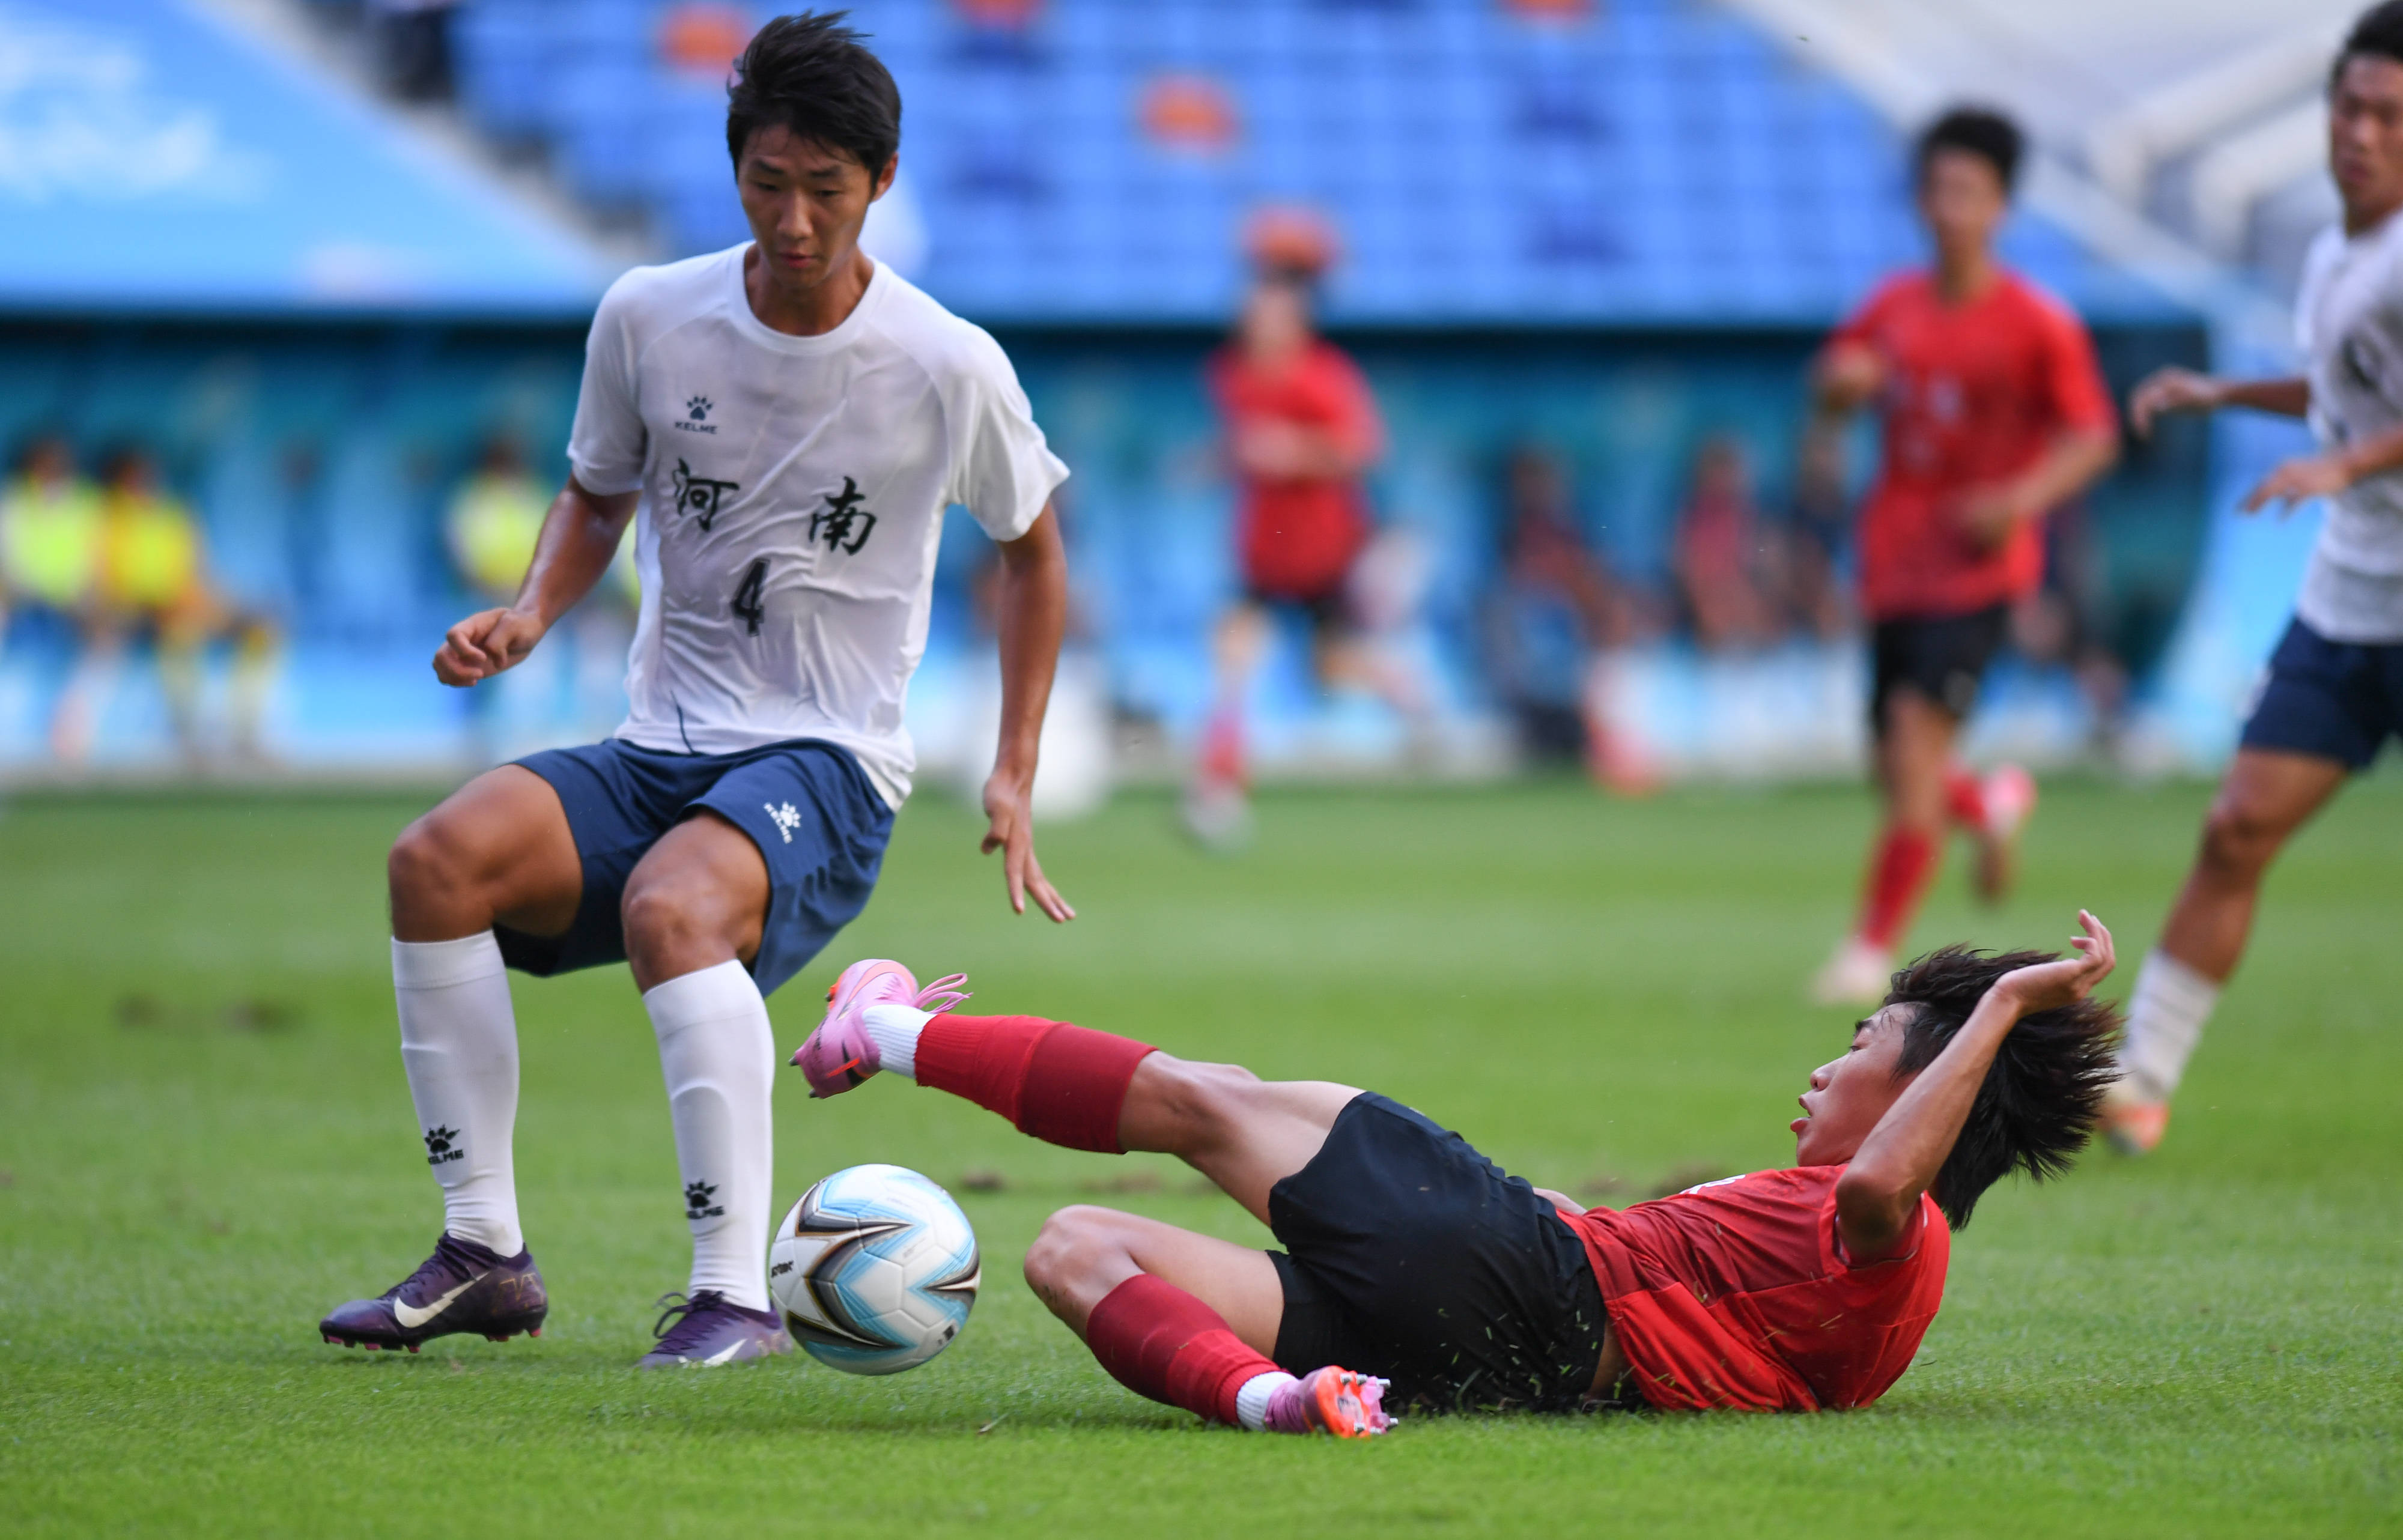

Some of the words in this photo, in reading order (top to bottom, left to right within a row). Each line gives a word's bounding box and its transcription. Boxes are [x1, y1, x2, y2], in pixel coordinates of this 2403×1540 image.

[674, 422, 717, 435] KELME
[731, 558, 770, 637] 4
[764, 802, 792, 844] KELME
